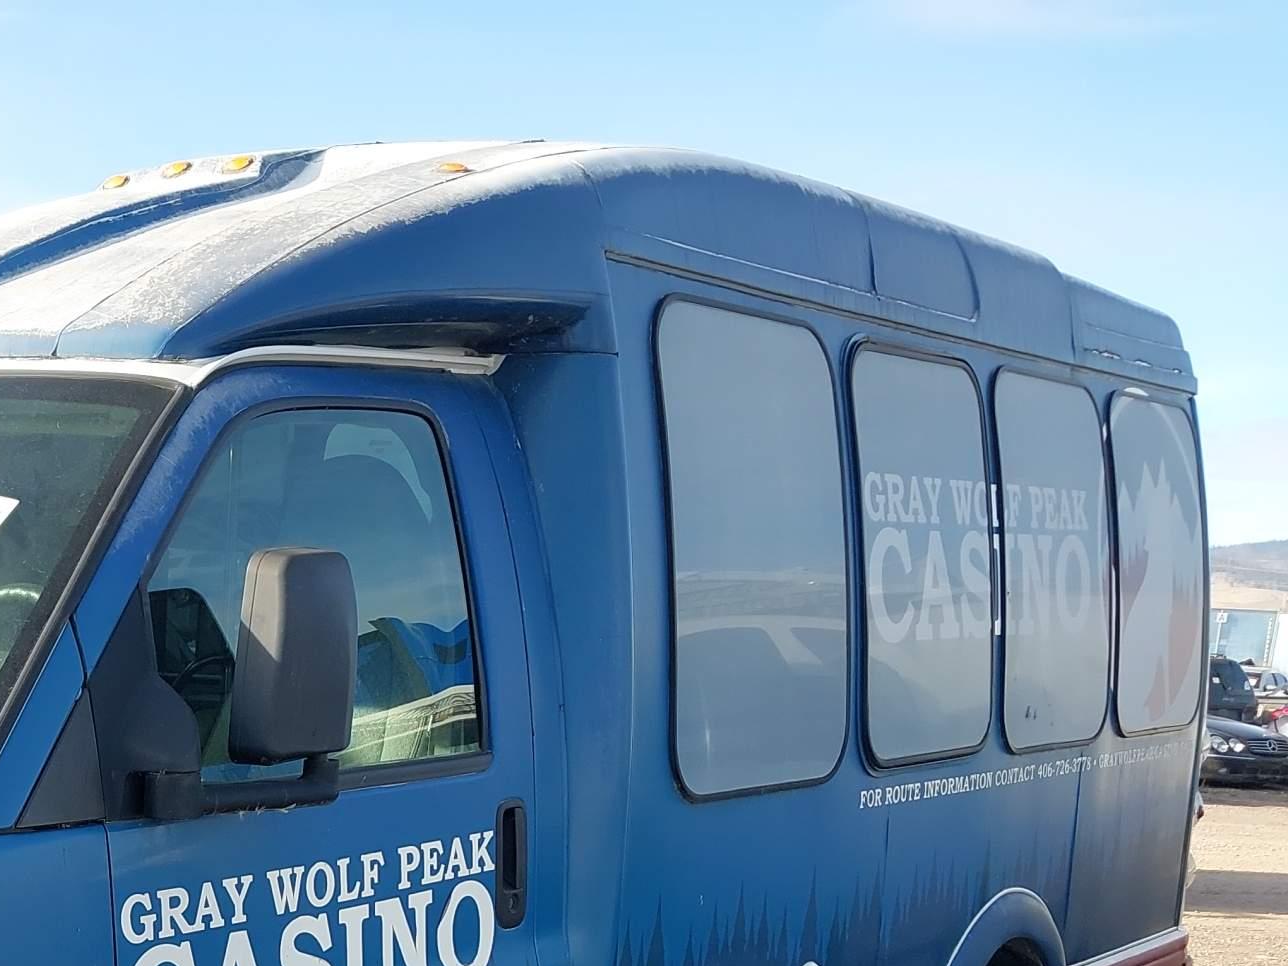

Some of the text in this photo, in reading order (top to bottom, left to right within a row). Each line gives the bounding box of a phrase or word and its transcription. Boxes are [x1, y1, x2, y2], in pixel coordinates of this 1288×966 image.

[864, 471, 1089, 530] GRAY WOLF PEAK
[869, 526, 1091, 643] CASINO
[860, 788, 883, 809] FOR
[885, 782, 921, 805] ROUTE
[923, 771, 993, 799] INFORMATION
[995, 764, 1036, 786] CONTACT
[1037, 756, 1091, 779] 406-726-3778
[121, 830, 495, 944] GRAY WOLF PEAK
